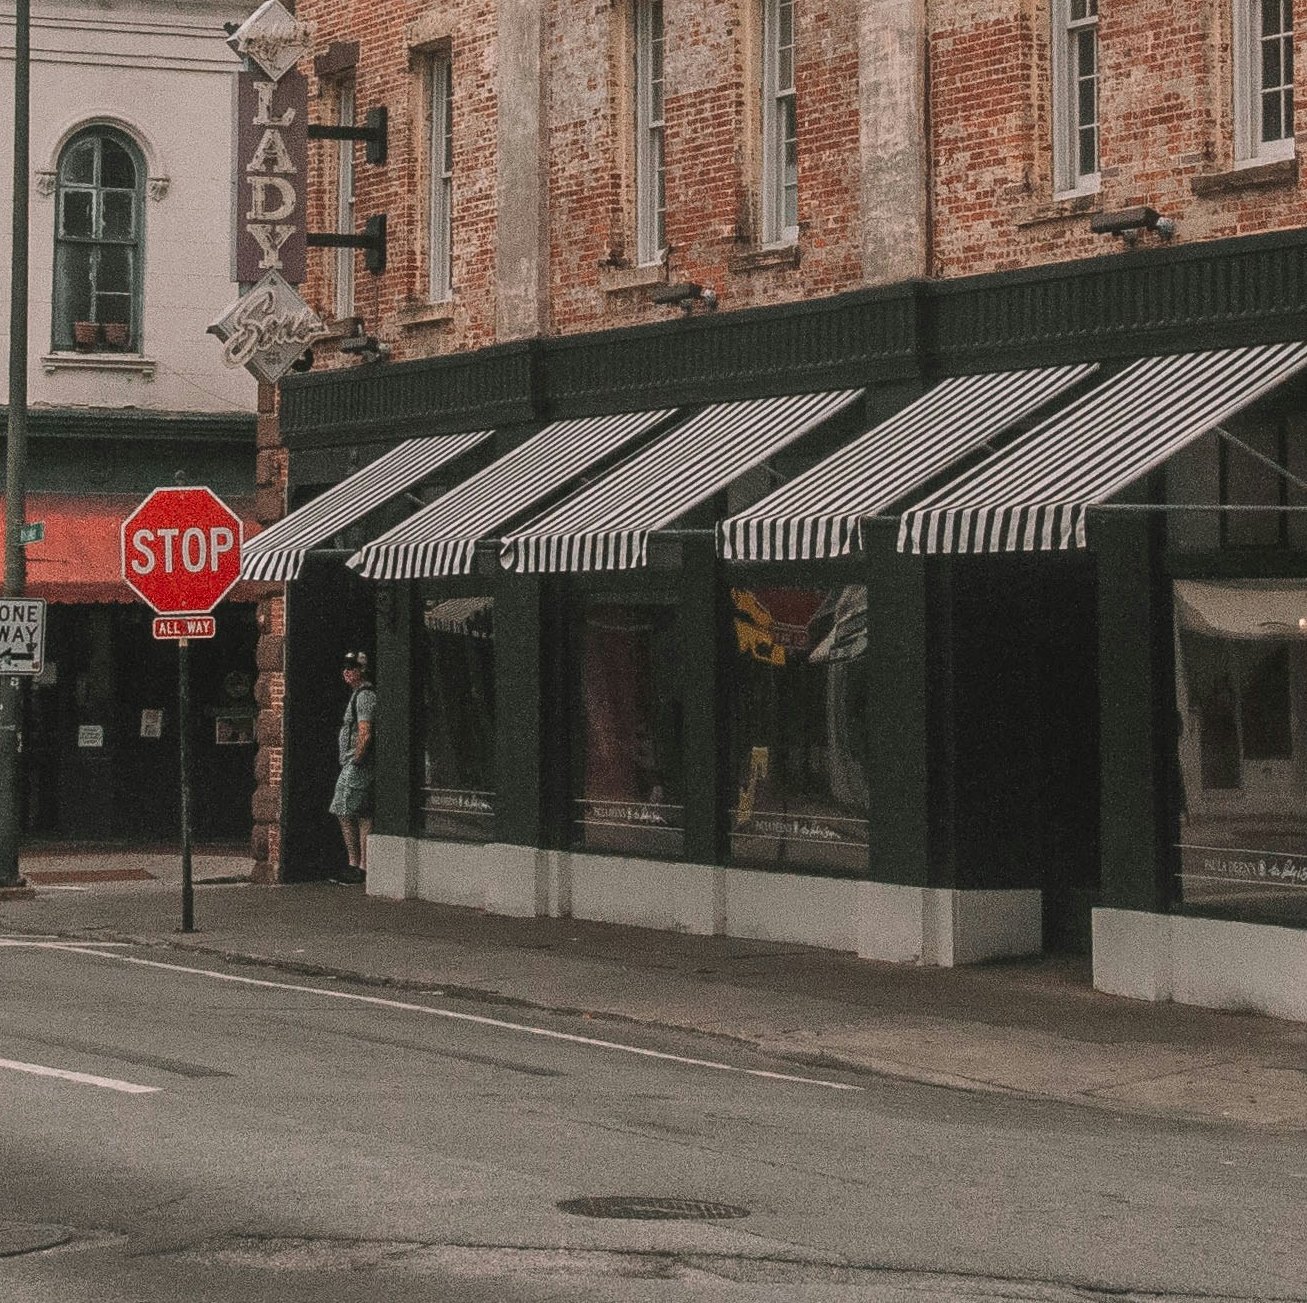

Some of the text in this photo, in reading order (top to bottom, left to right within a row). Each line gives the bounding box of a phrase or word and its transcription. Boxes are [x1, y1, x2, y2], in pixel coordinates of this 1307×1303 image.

[246, 81, 298, 269] LADY
[131, 527, 234, 575] STOP
[159, 619, 211, 635] ALL WAY
